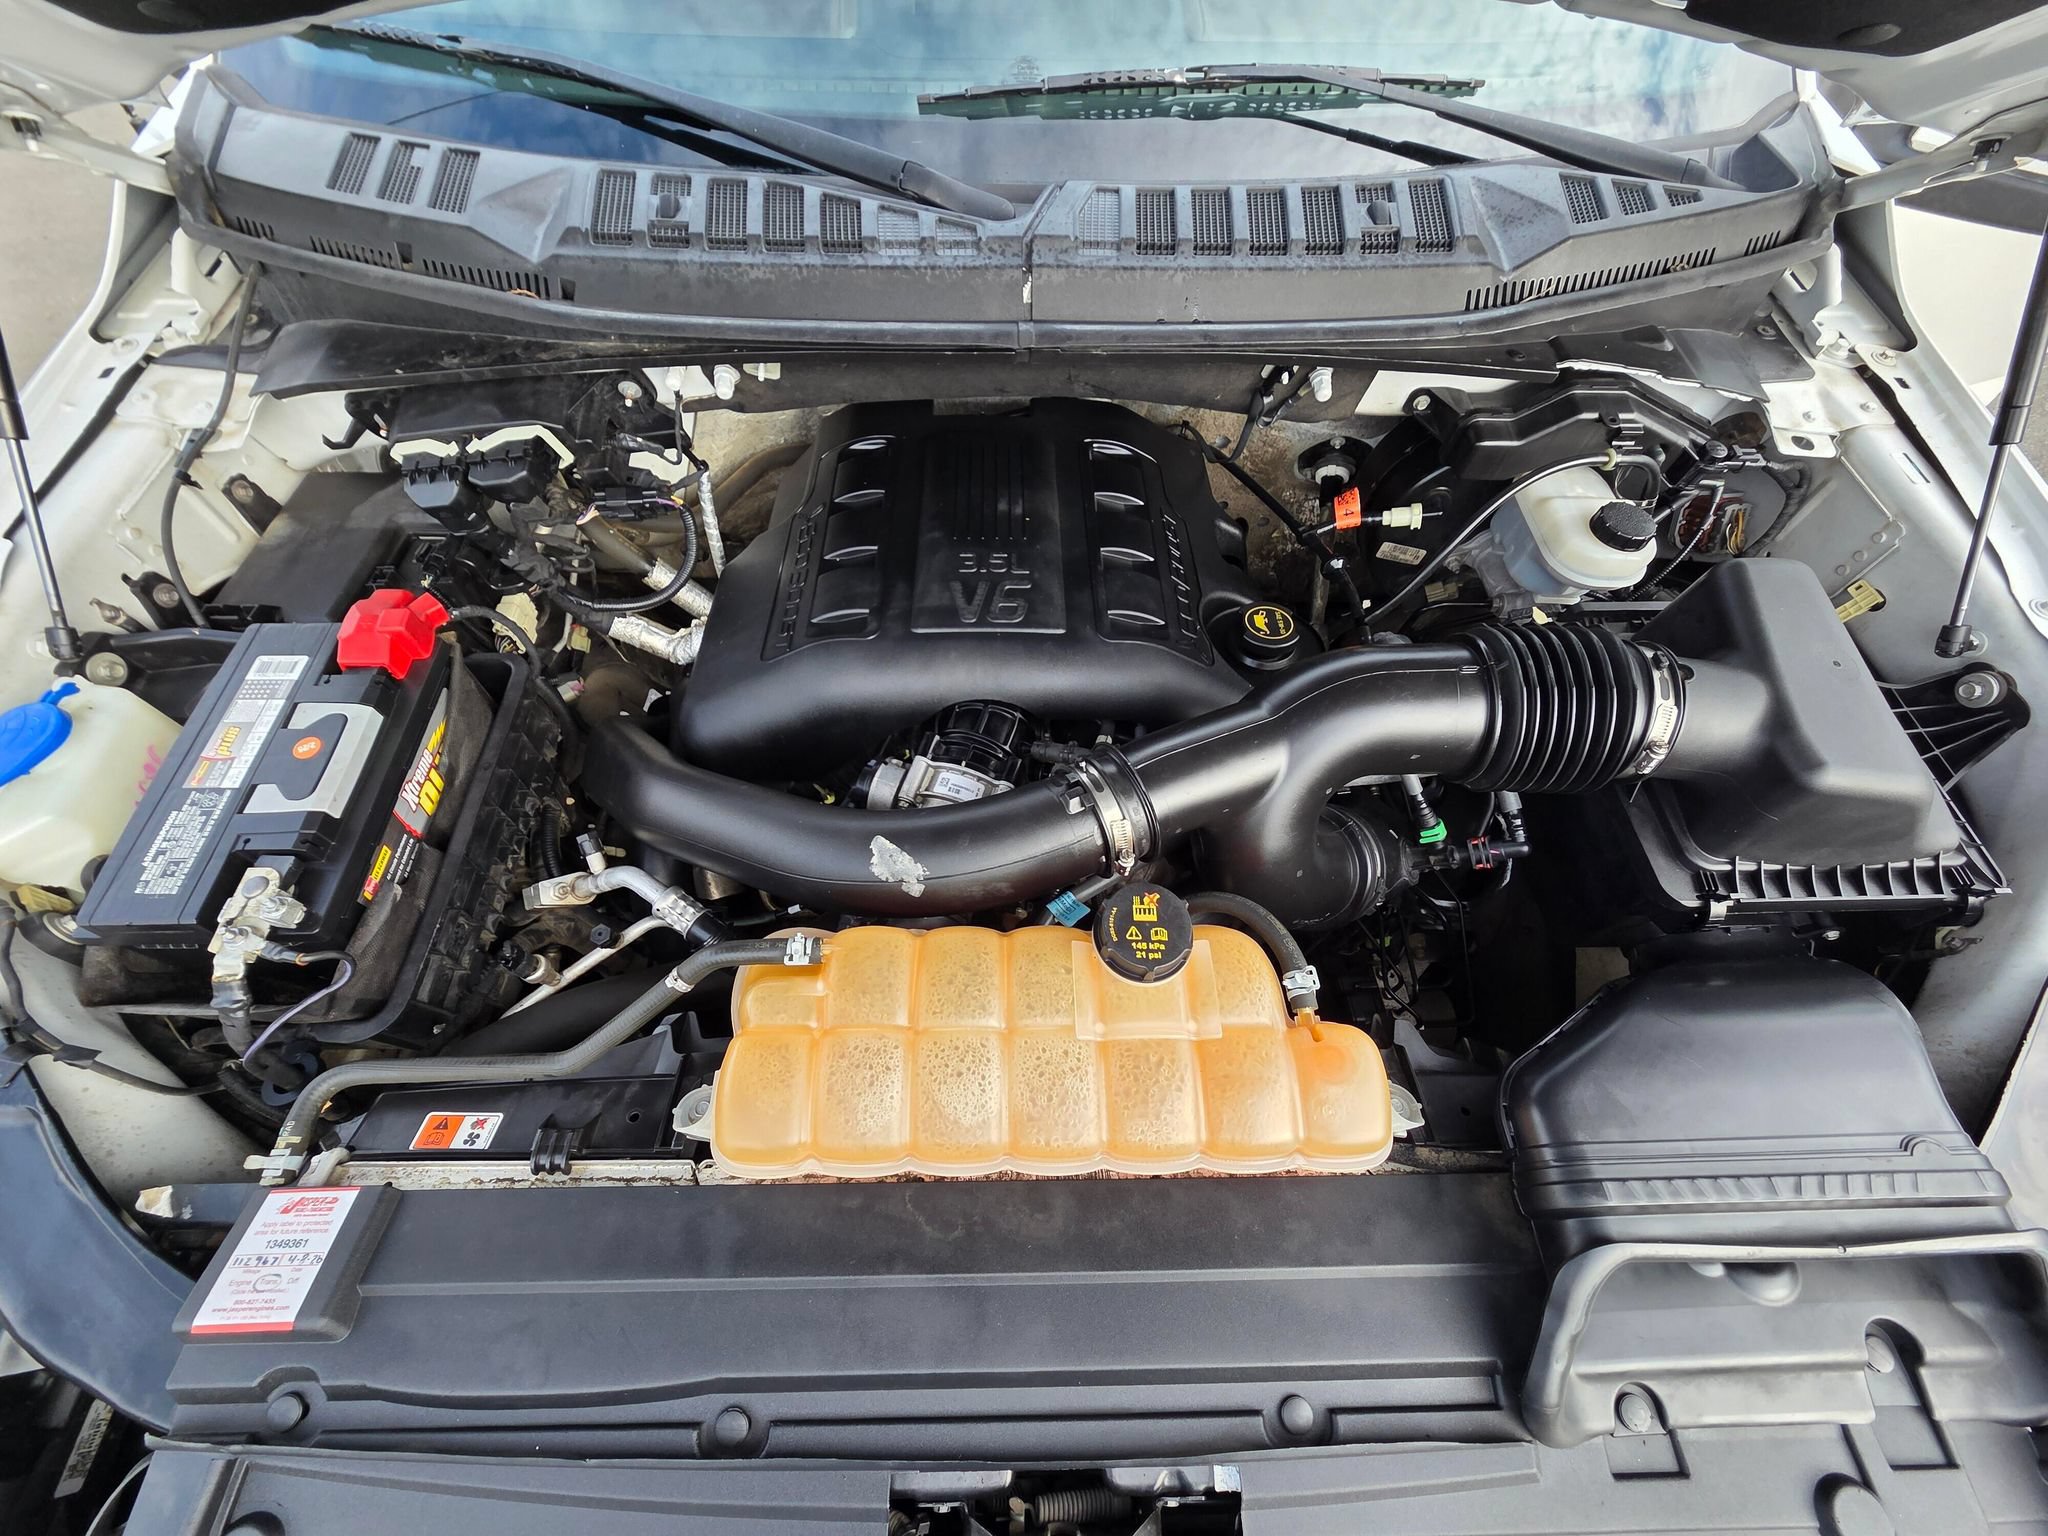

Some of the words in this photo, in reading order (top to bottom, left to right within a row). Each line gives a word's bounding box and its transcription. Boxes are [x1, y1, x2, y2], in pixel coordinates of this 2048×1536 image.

[958, 553, 1030, 574] 3.5L
[950, 580, 1032, 623] V6
[400, 747, 434, 813] Xtreme
[1131, 942, 1147, 950] 145
[1149, 942, 1166, 950] kPa
[1148, 952, 1162, 960] psi
[265, 1238, 310, 1249] 1349361
